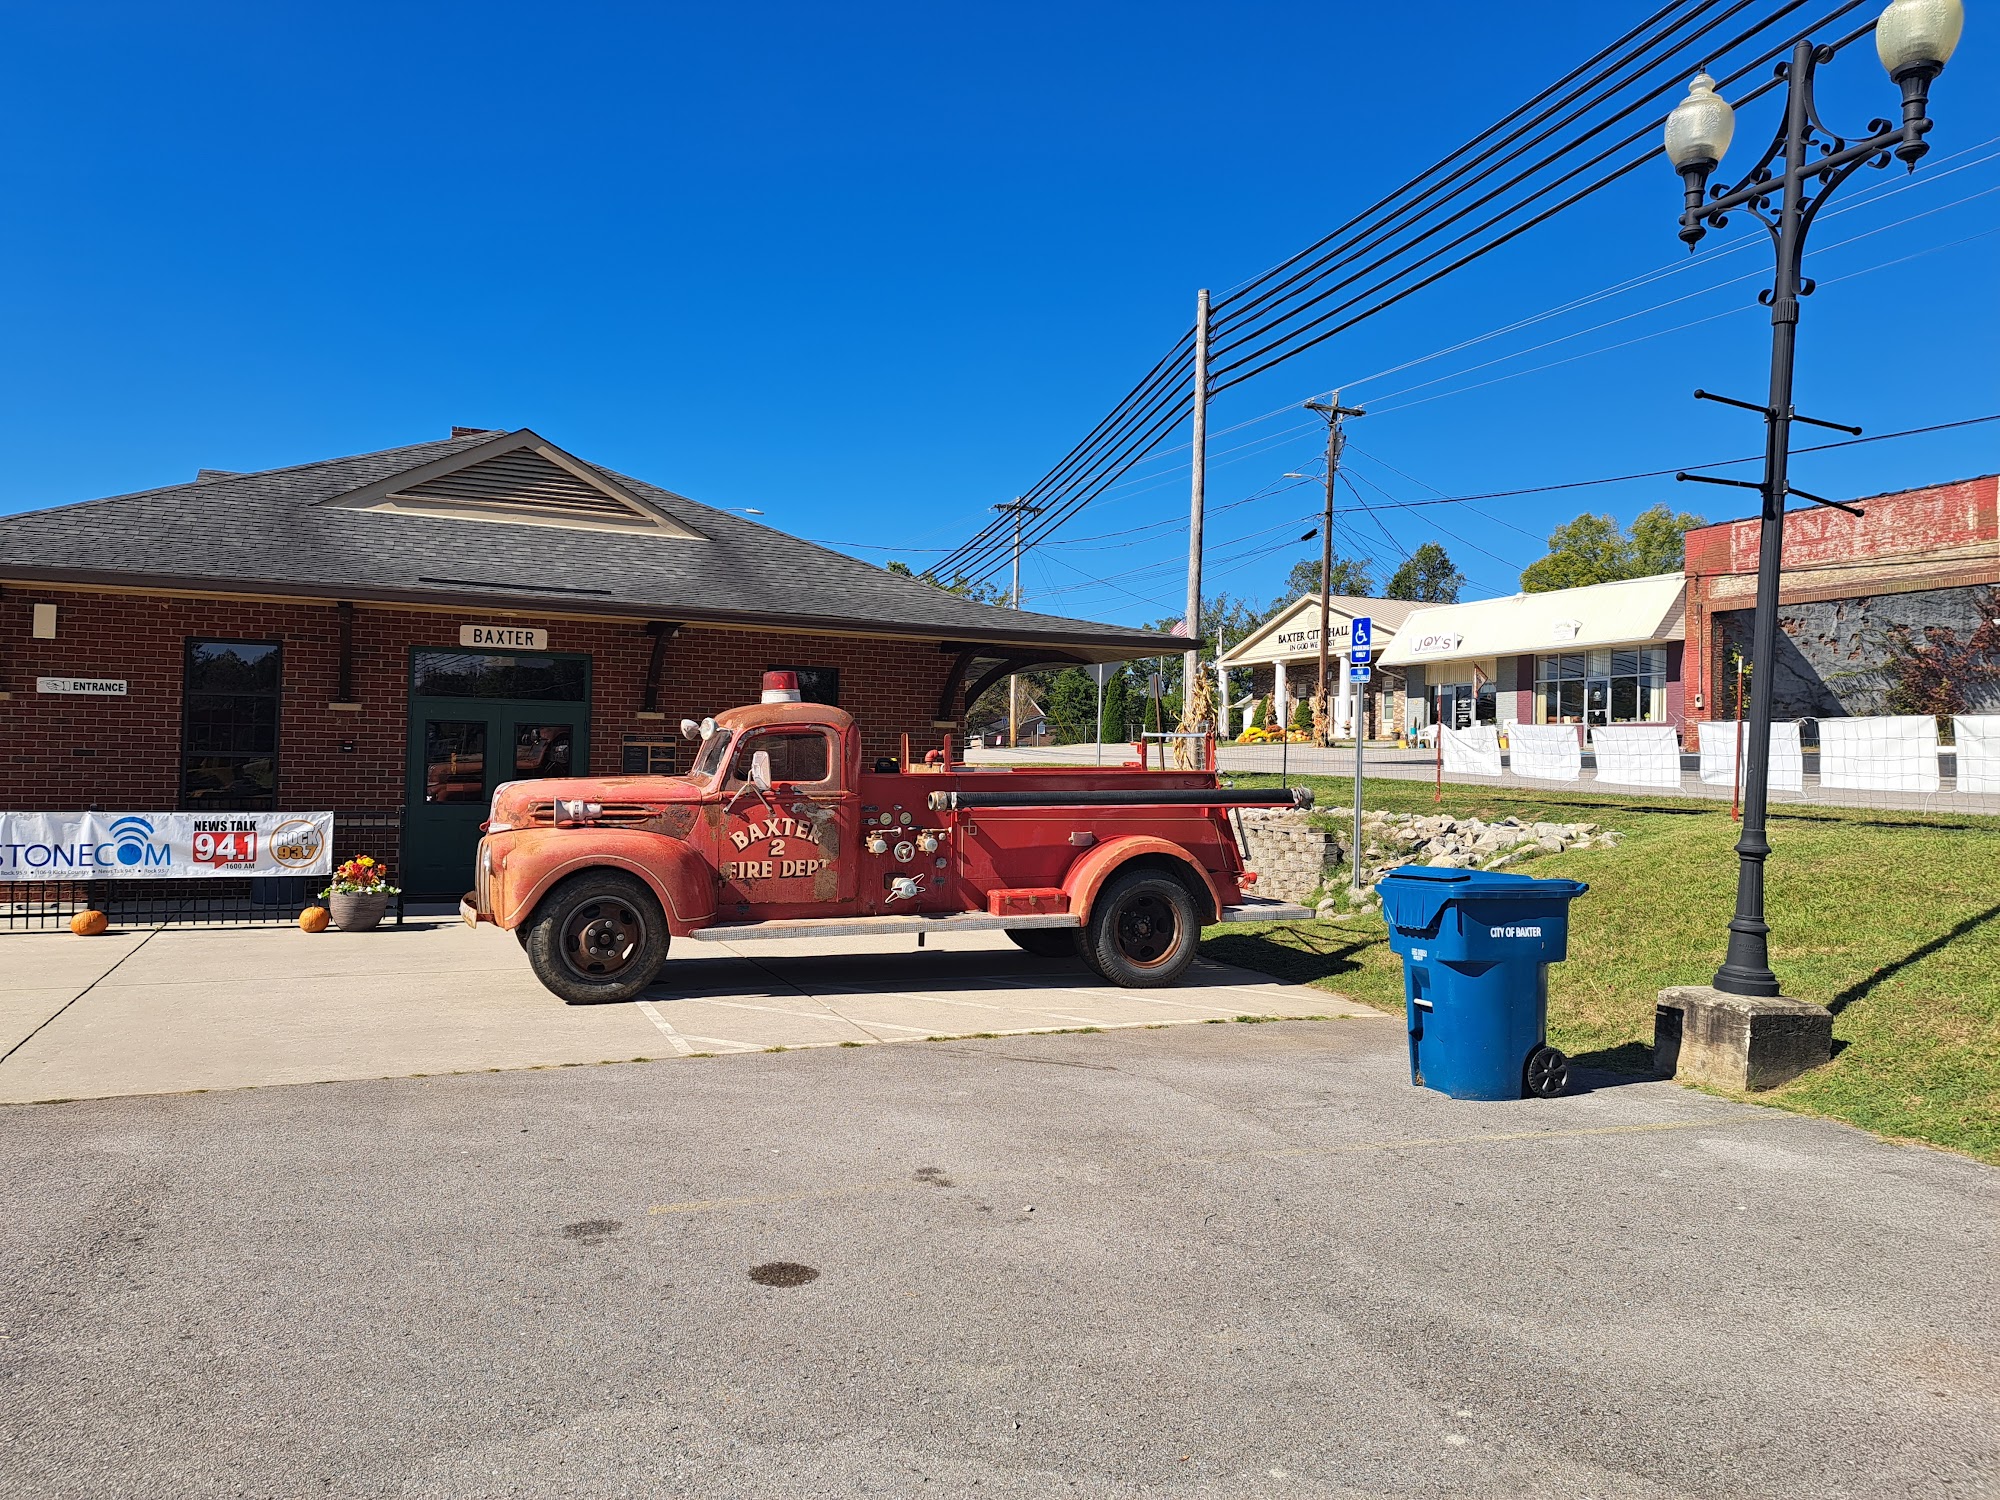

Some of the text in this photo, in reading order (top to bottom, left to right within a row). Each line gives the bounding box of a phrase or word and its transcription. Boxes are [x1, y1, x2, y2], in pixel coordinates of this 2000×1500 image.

[473, 628, 534, 646] BAXTER
[1278, 626, 1350, 644] BAXTER CIT HALL
[1414, 635, 1452, 652] JOY'S
[1296, 642, 1309, 650] GOD
[72, 682, 125, 692] ENTRANCE
[194, 820, 257, 832] NEWS TALK
[277, 831, 319, 846] ROCK
[729, 818, 823, 852] BAXTER
[0, 843, 171, 868] TONECOM
[195, 834, 255, 861] 94.1
[277, 846, 318, 860] 93.7
[770, 839, 786, 856] 2
[1490, 926, 1541, 938] CITY OF BAXTER
